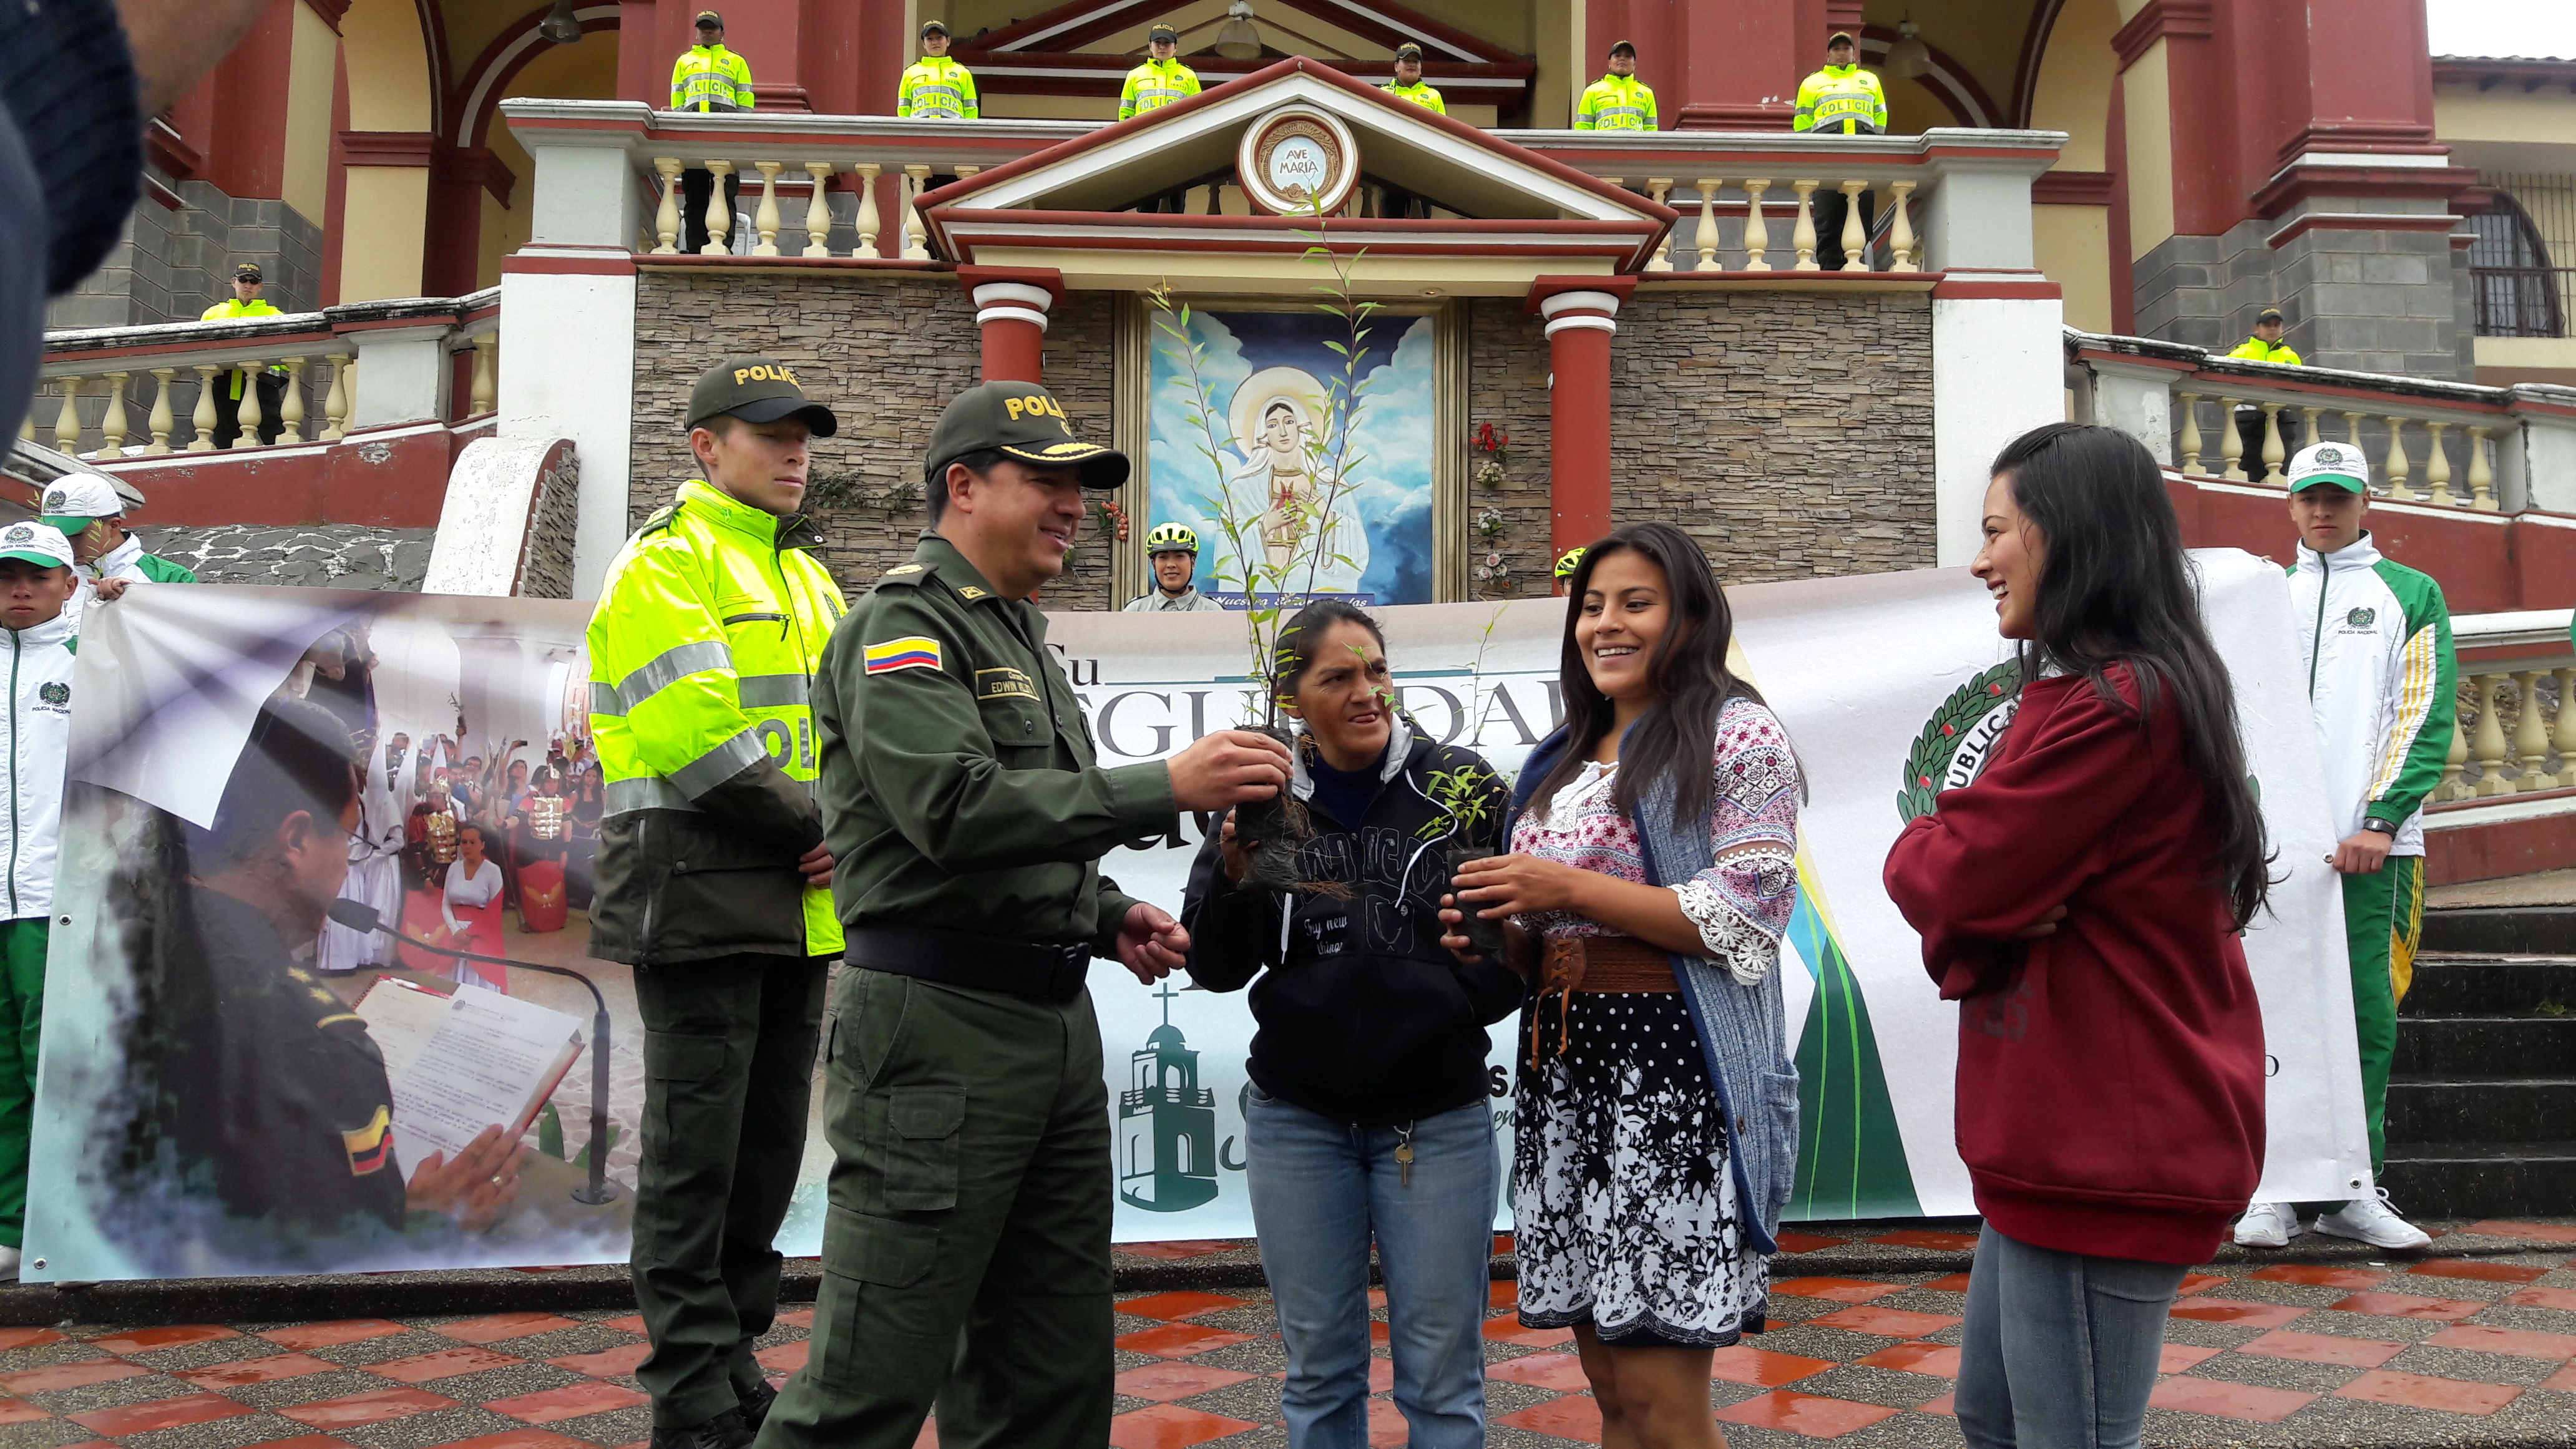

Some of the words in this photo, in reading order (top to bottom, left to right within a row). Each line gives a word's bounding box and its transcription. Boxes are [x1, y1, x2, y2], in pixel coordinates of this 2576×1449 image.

[687, 81, 729, 97] OLICIA
[912, 95, 959, 111] POLICIA
[1139, 97, 1181, 112] POLIC
[1822, 101, 1871, 115] POLICIA
[1286, 150, 1307, 159] AVE
[1280, 161, 1319, 173] MARIA
[991, 681, 1017, 693] EDWIN
[1326, 915, 1348, 931] new
